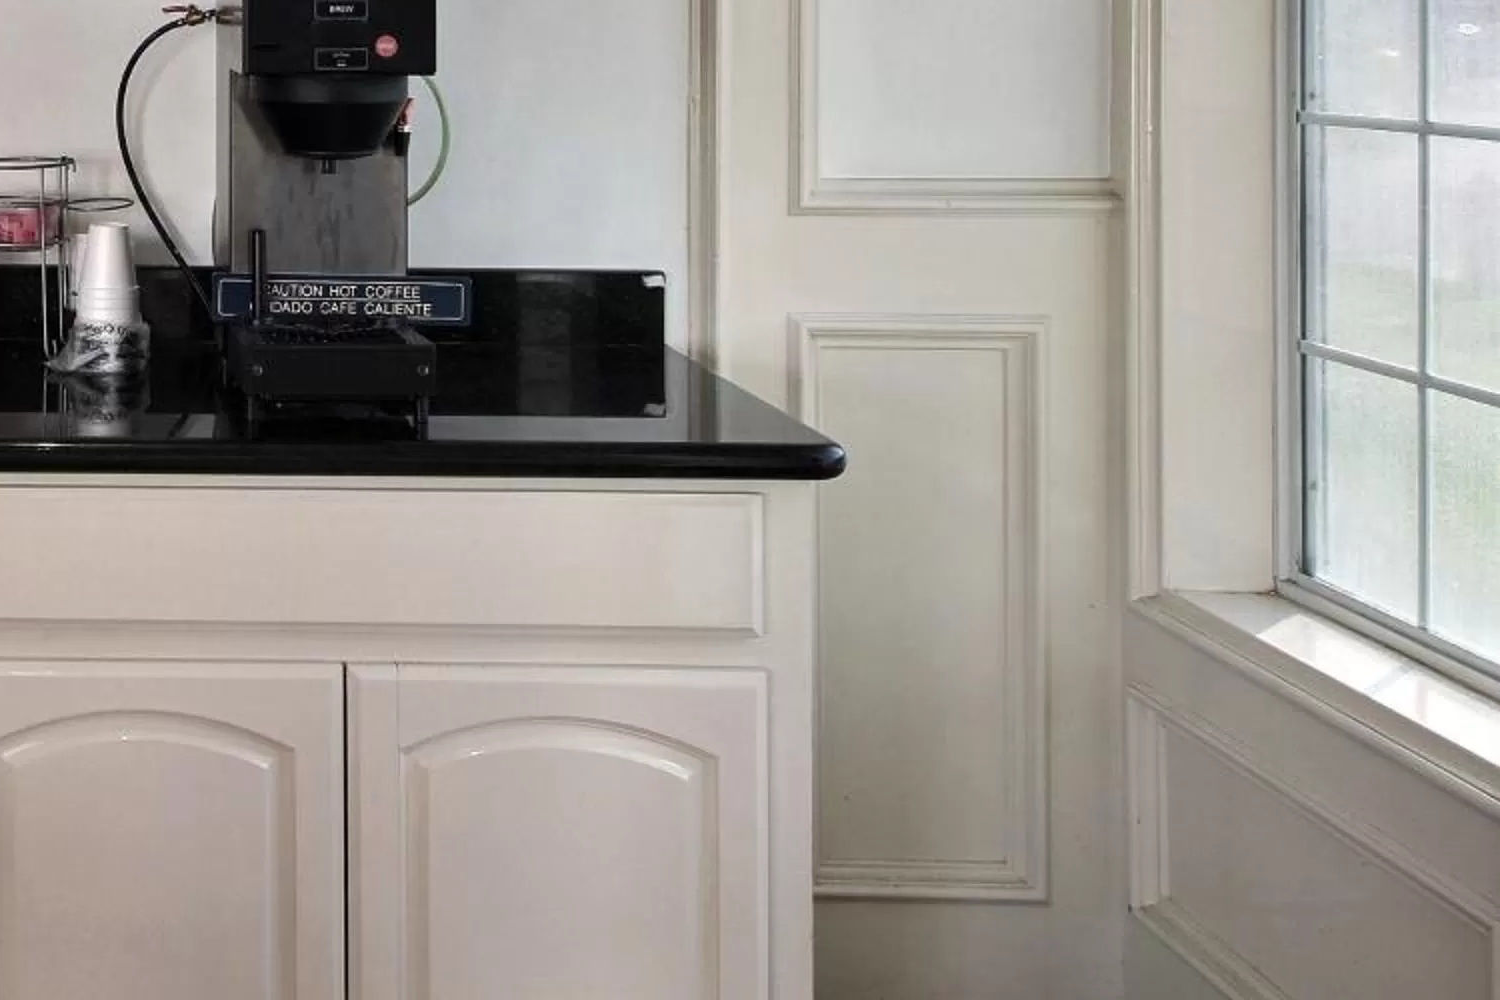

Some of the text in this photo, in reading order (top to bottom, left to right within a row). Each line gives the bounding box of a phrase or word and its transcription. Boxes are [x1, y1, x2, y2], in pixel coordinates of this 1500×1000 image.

[329, 285, 357, 297] HOT
[365, 285, 421, 299] COFFEE
[320, 301, 357, 315] CAFE
[364, 302, 432, 317] CALIENTE
